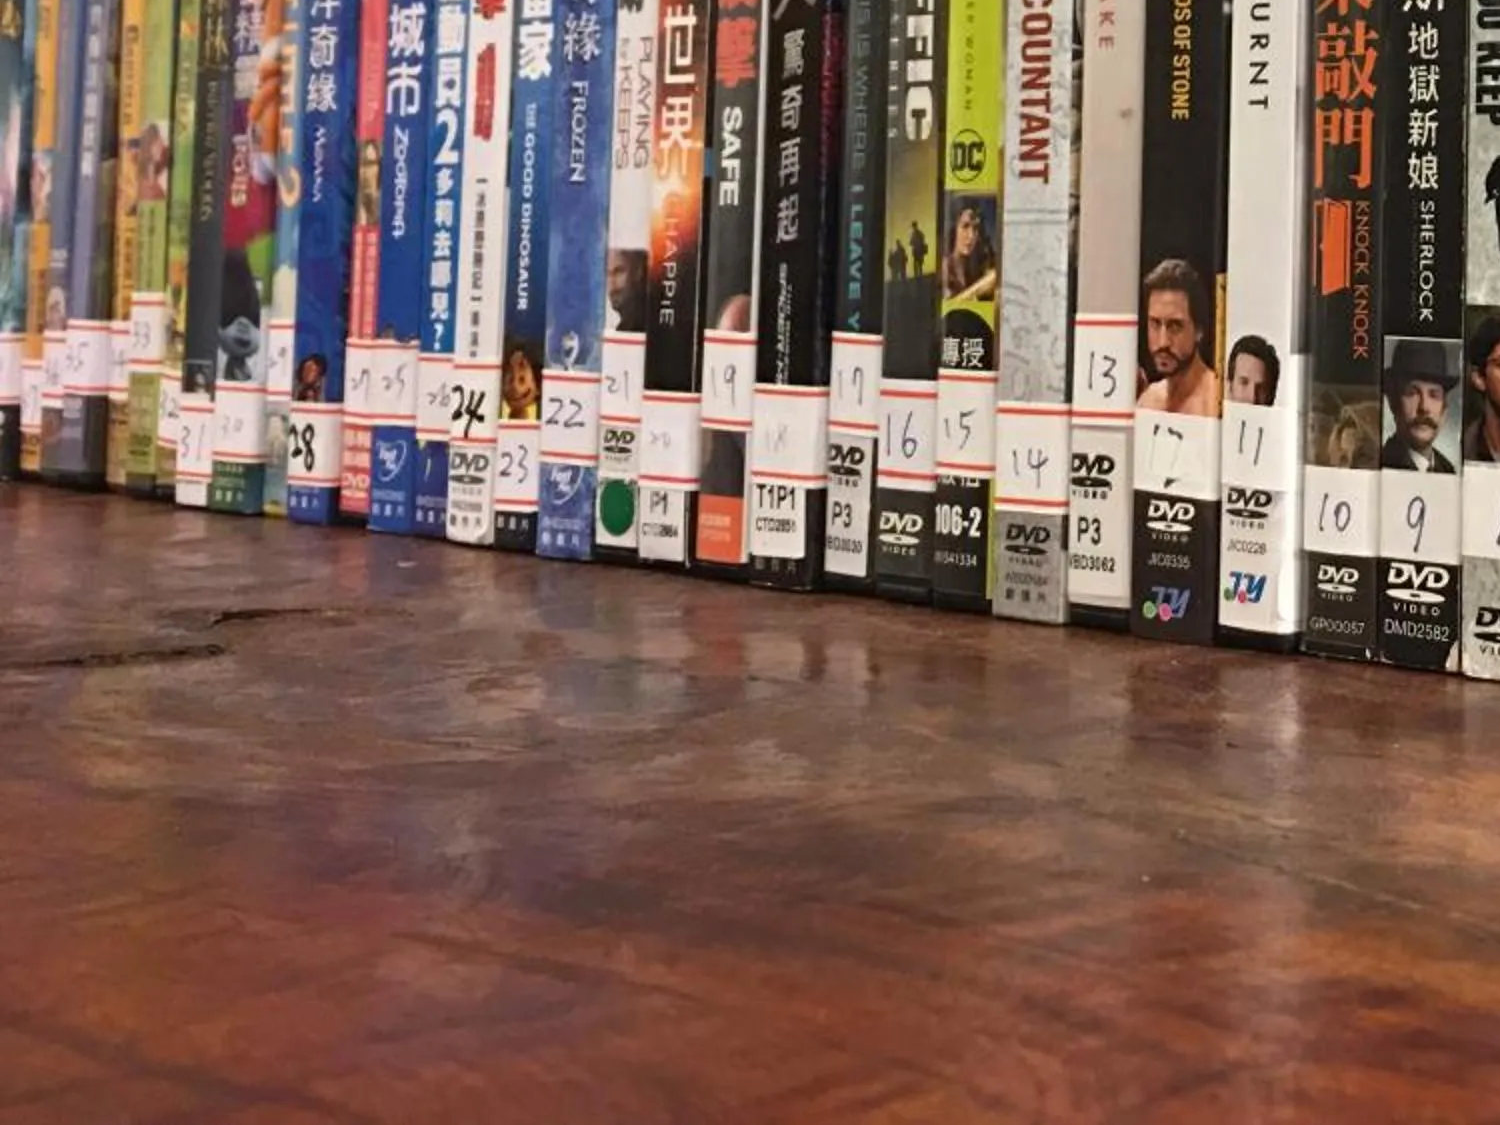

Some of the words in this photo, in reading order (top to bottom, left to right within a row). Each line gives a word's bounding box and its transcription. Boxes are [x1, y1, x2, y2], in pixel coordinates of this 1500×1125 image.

[1172, 26, 1192, 54] OF
[963, 36, 975, 112] WOMAN
[1171, 54, 1191, 121] STONE
[633, 35, 655, 170] PLAYING
[1406, 21, 1441, 191] 地獄新娘
[568, 79, 590, 183] FROZEN
[521, 132, 537, 199] GOOD
[718, 106, 743, 207] SAFE
[515, 202, 533, 312] DINOSAUR
[658, 191, 680, 327] CHAPPIE
[848, 204, 864, 300] LEAVE
[1352, 200, 1372, 274] KNOCK
[1418, 199, 1437, 322] SHERLOCK
[1351, 283, 1370, 360] KNOCK
[605, 370, 630, 404] 21
[709, 364, 738, 408] 19
[836, 366, 865, 406] 17
[1087, 350, 1117, 399] 13
[451, 384, 485, 439] 24
[545, 397, 585, 428] 22
[886, 410, 918, 458] 16
[943, 409, 977, 452] 15
[288, 423, 315, 472] 28
[603, 429, 636, 445] DVD
[1239, 420, 1263, 467] 11
[499, 444, 529, 484] 23
[1012, 447, 1048, 489] 14
[755, 483, 797, 511] T1P1
[831, 500, 852, 528] P3
[934, 503, 983, 538] 106-2
[1318, 493, 1352, 534] 10
[1076, 516, 1101, 545] P3
[1406, 494, 1427, 555] 9
[1384, 617, 1450, 642] DMD2582
